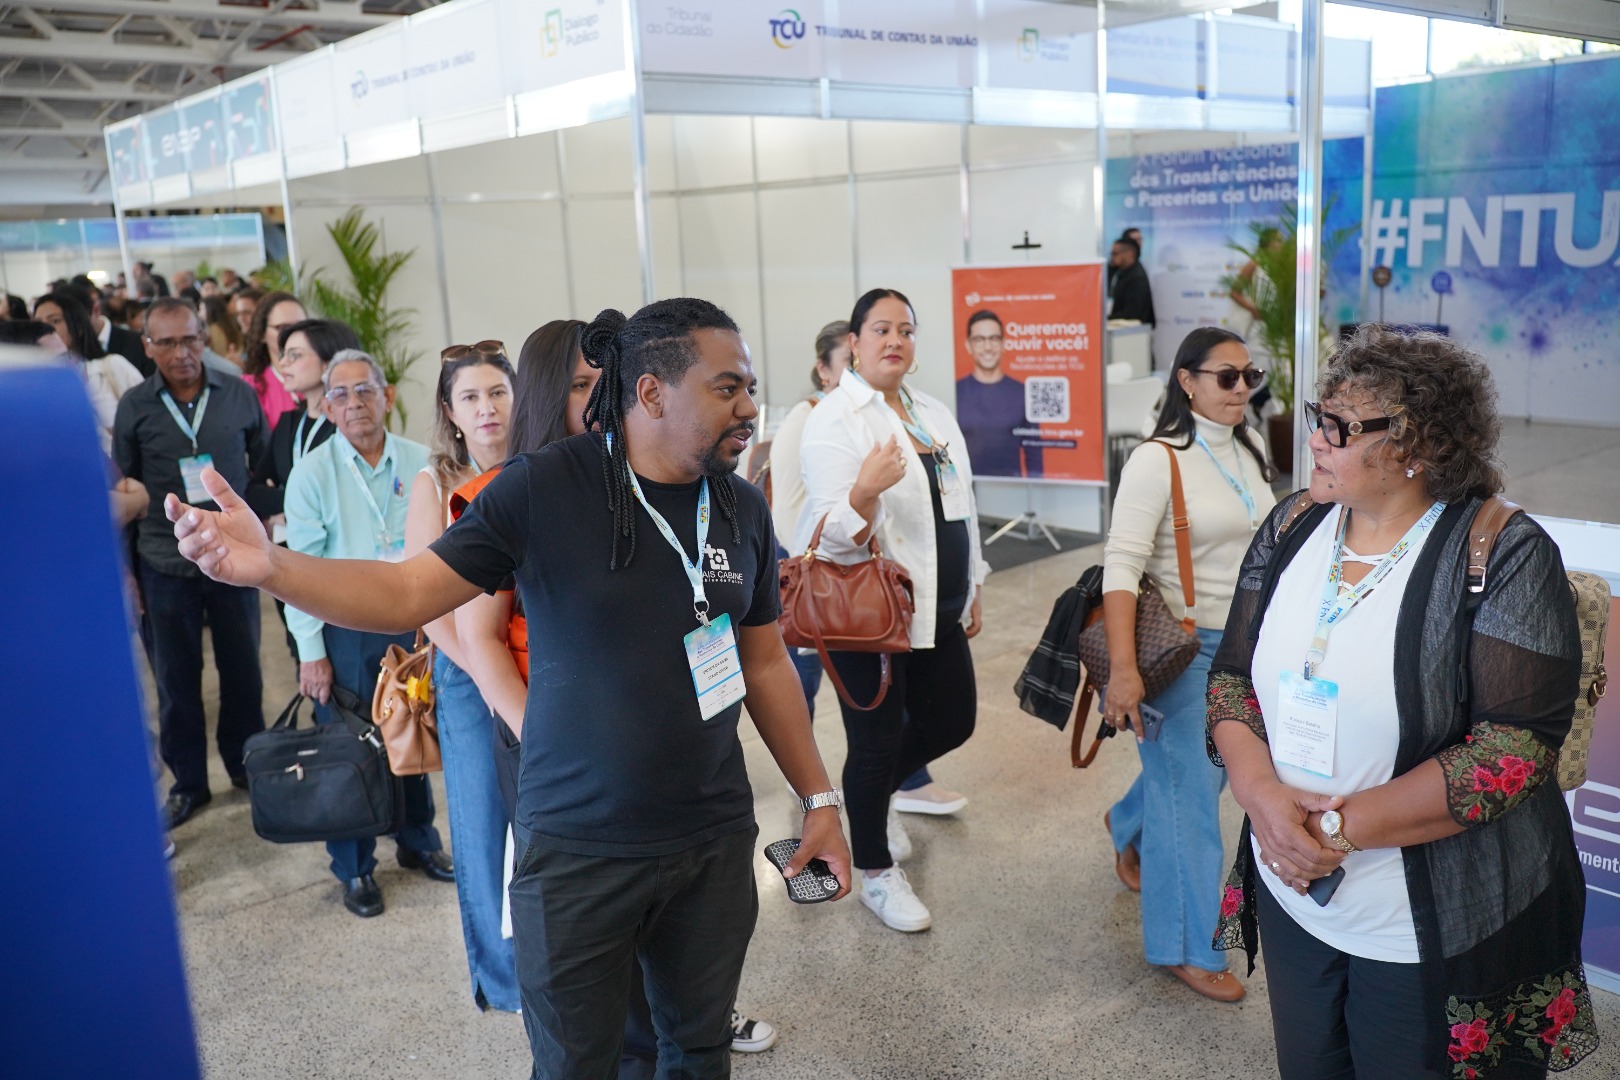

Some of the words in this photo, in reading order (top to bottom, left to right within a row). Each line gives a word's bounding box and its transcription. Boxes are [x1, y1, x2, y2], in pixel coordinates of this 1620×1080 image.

[667, 7, 712, 22] Tribunal
[646, 23, 662, 34] do
[769, 18, 806, 41] TCU
[815, 25, 867, 40] TRIBUNAL
[871, 30, 884, 42] DE
[888, 31, 927, 44] CONTAS
[929, 34, 943, 45] DA
[1162, 162, 1298, 187] Transferências
[1124, 196, 1135, 209] e
[1138, 187, 1218, 207] Parcerias
[1221, 185, 1245, 204] da
[1359, 191, 1620, 269] #FNTU
[1006, 322, 1087, 337] Queremos
[1004, 337, 1042, 350] ouvir
[1045, 337, 1089, 351] você!
[1418, 522, 1428, 531] X
[1425, 503, 1444, 525] FNTU
[717, 571, 743, 580] CABINE
[1327, 607, 1343, 623] CAIXA
[1576, 846, 1620, 874] ment
